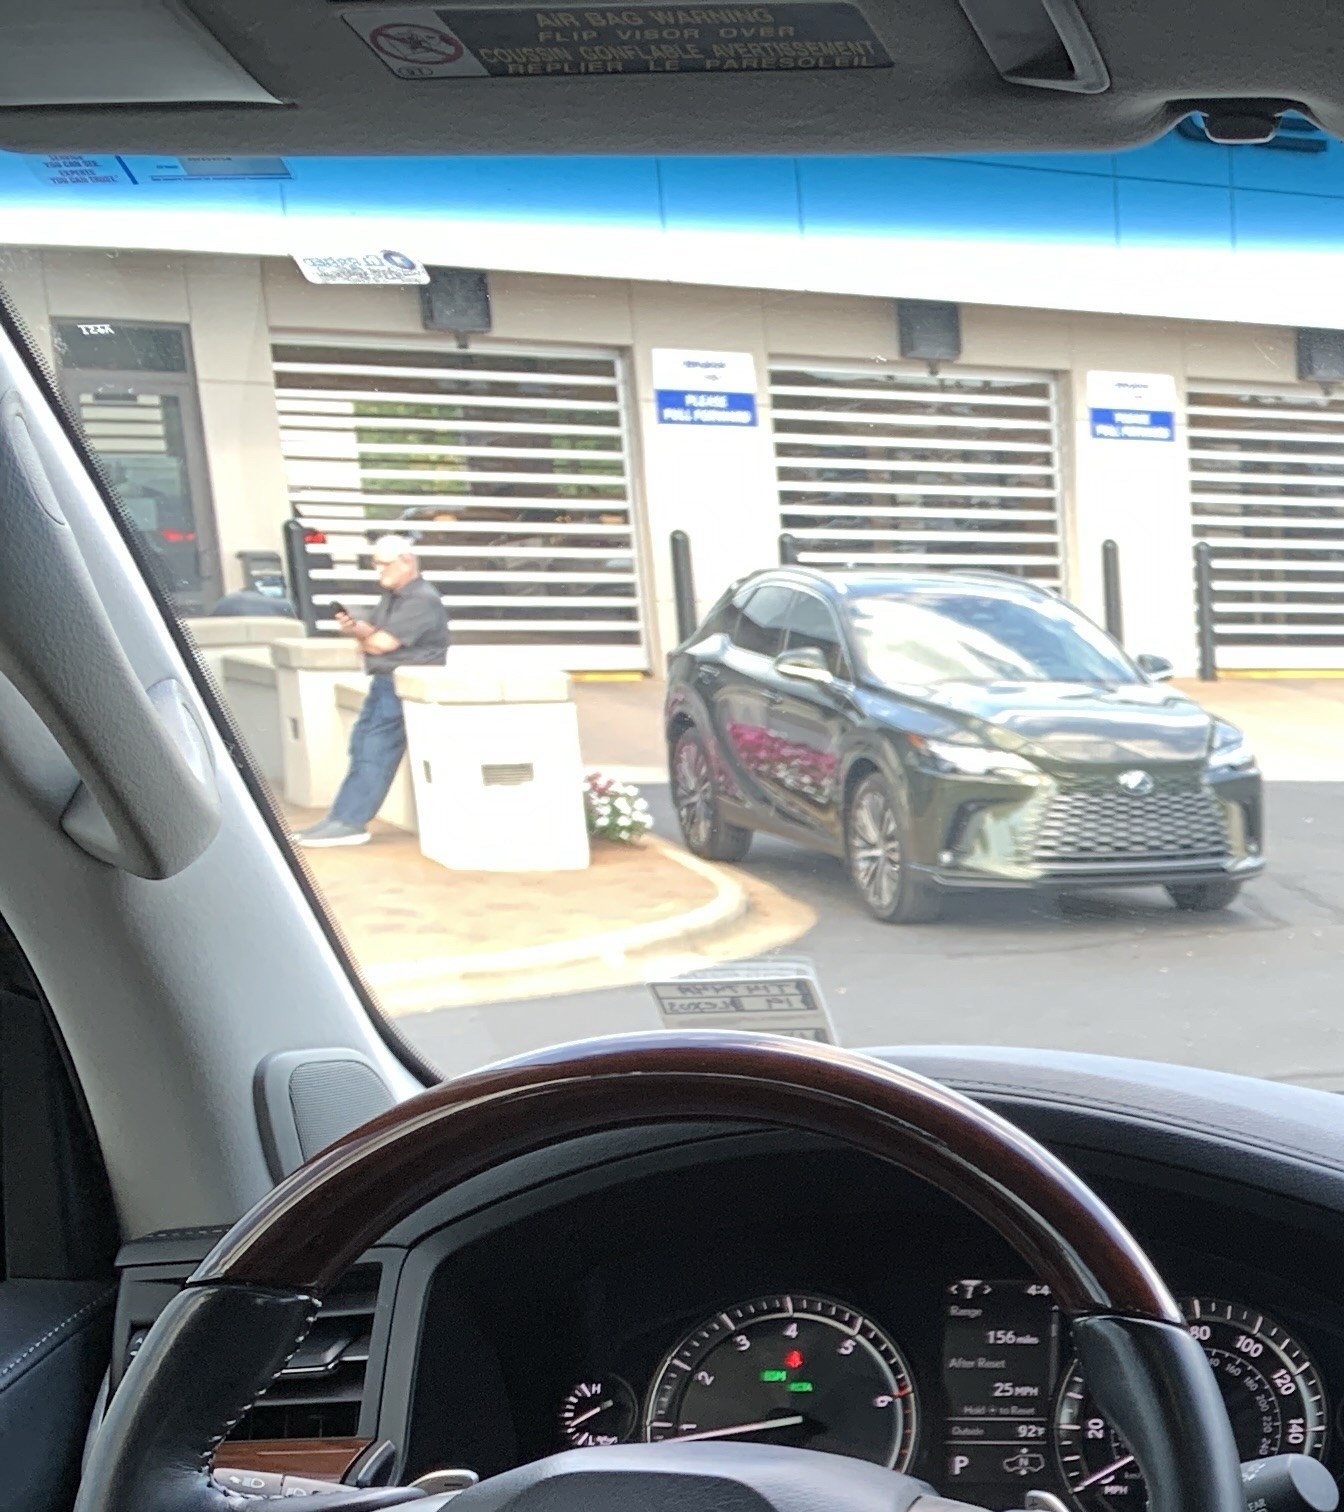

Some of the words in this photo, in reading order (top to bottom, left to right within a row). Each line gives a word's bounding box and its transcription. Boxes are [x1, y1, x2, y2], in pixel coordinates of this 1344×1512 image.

[536, 12, 580, 27] AIR
[588, 11, 642, 26] BAG
[649, 9, 774, 25] WARNING
[539, 31, 598, 42] FLIP
[617, 29, 701, 40] VISOR
[720, 26, 795, 38] OVER
[478, 46, 572, 62] COUSSIN
[712, 41, 874, 58] AVERTISSEMENT
[508, 62, 623, 74] REPLIER
[649, 60, 680, 71] LE
[706, 57, 870, 70] PARESOLEIL
[949, 1305, 982, 1318] Range
[783, 1322, 799, 1338] 4
[735, 1335, 751, 1351] 3
[837, 1339, 857, 1355] 5
[1235, 1335, 1263, 1358] 100
[698, 1371, 715, 1386] 2
[1272, 1368, 1296, 1396] 120
[591, 1383, 602, 1395] H
[1087, 1418, 1105, 1440] 20
[1287, 1418, 1305, 1445] 140
[953, 1456, 969, 1475] P
[1103, 1485, 1129, 1496] MPH
[1248, 1499, 1267, 1512] EAR
